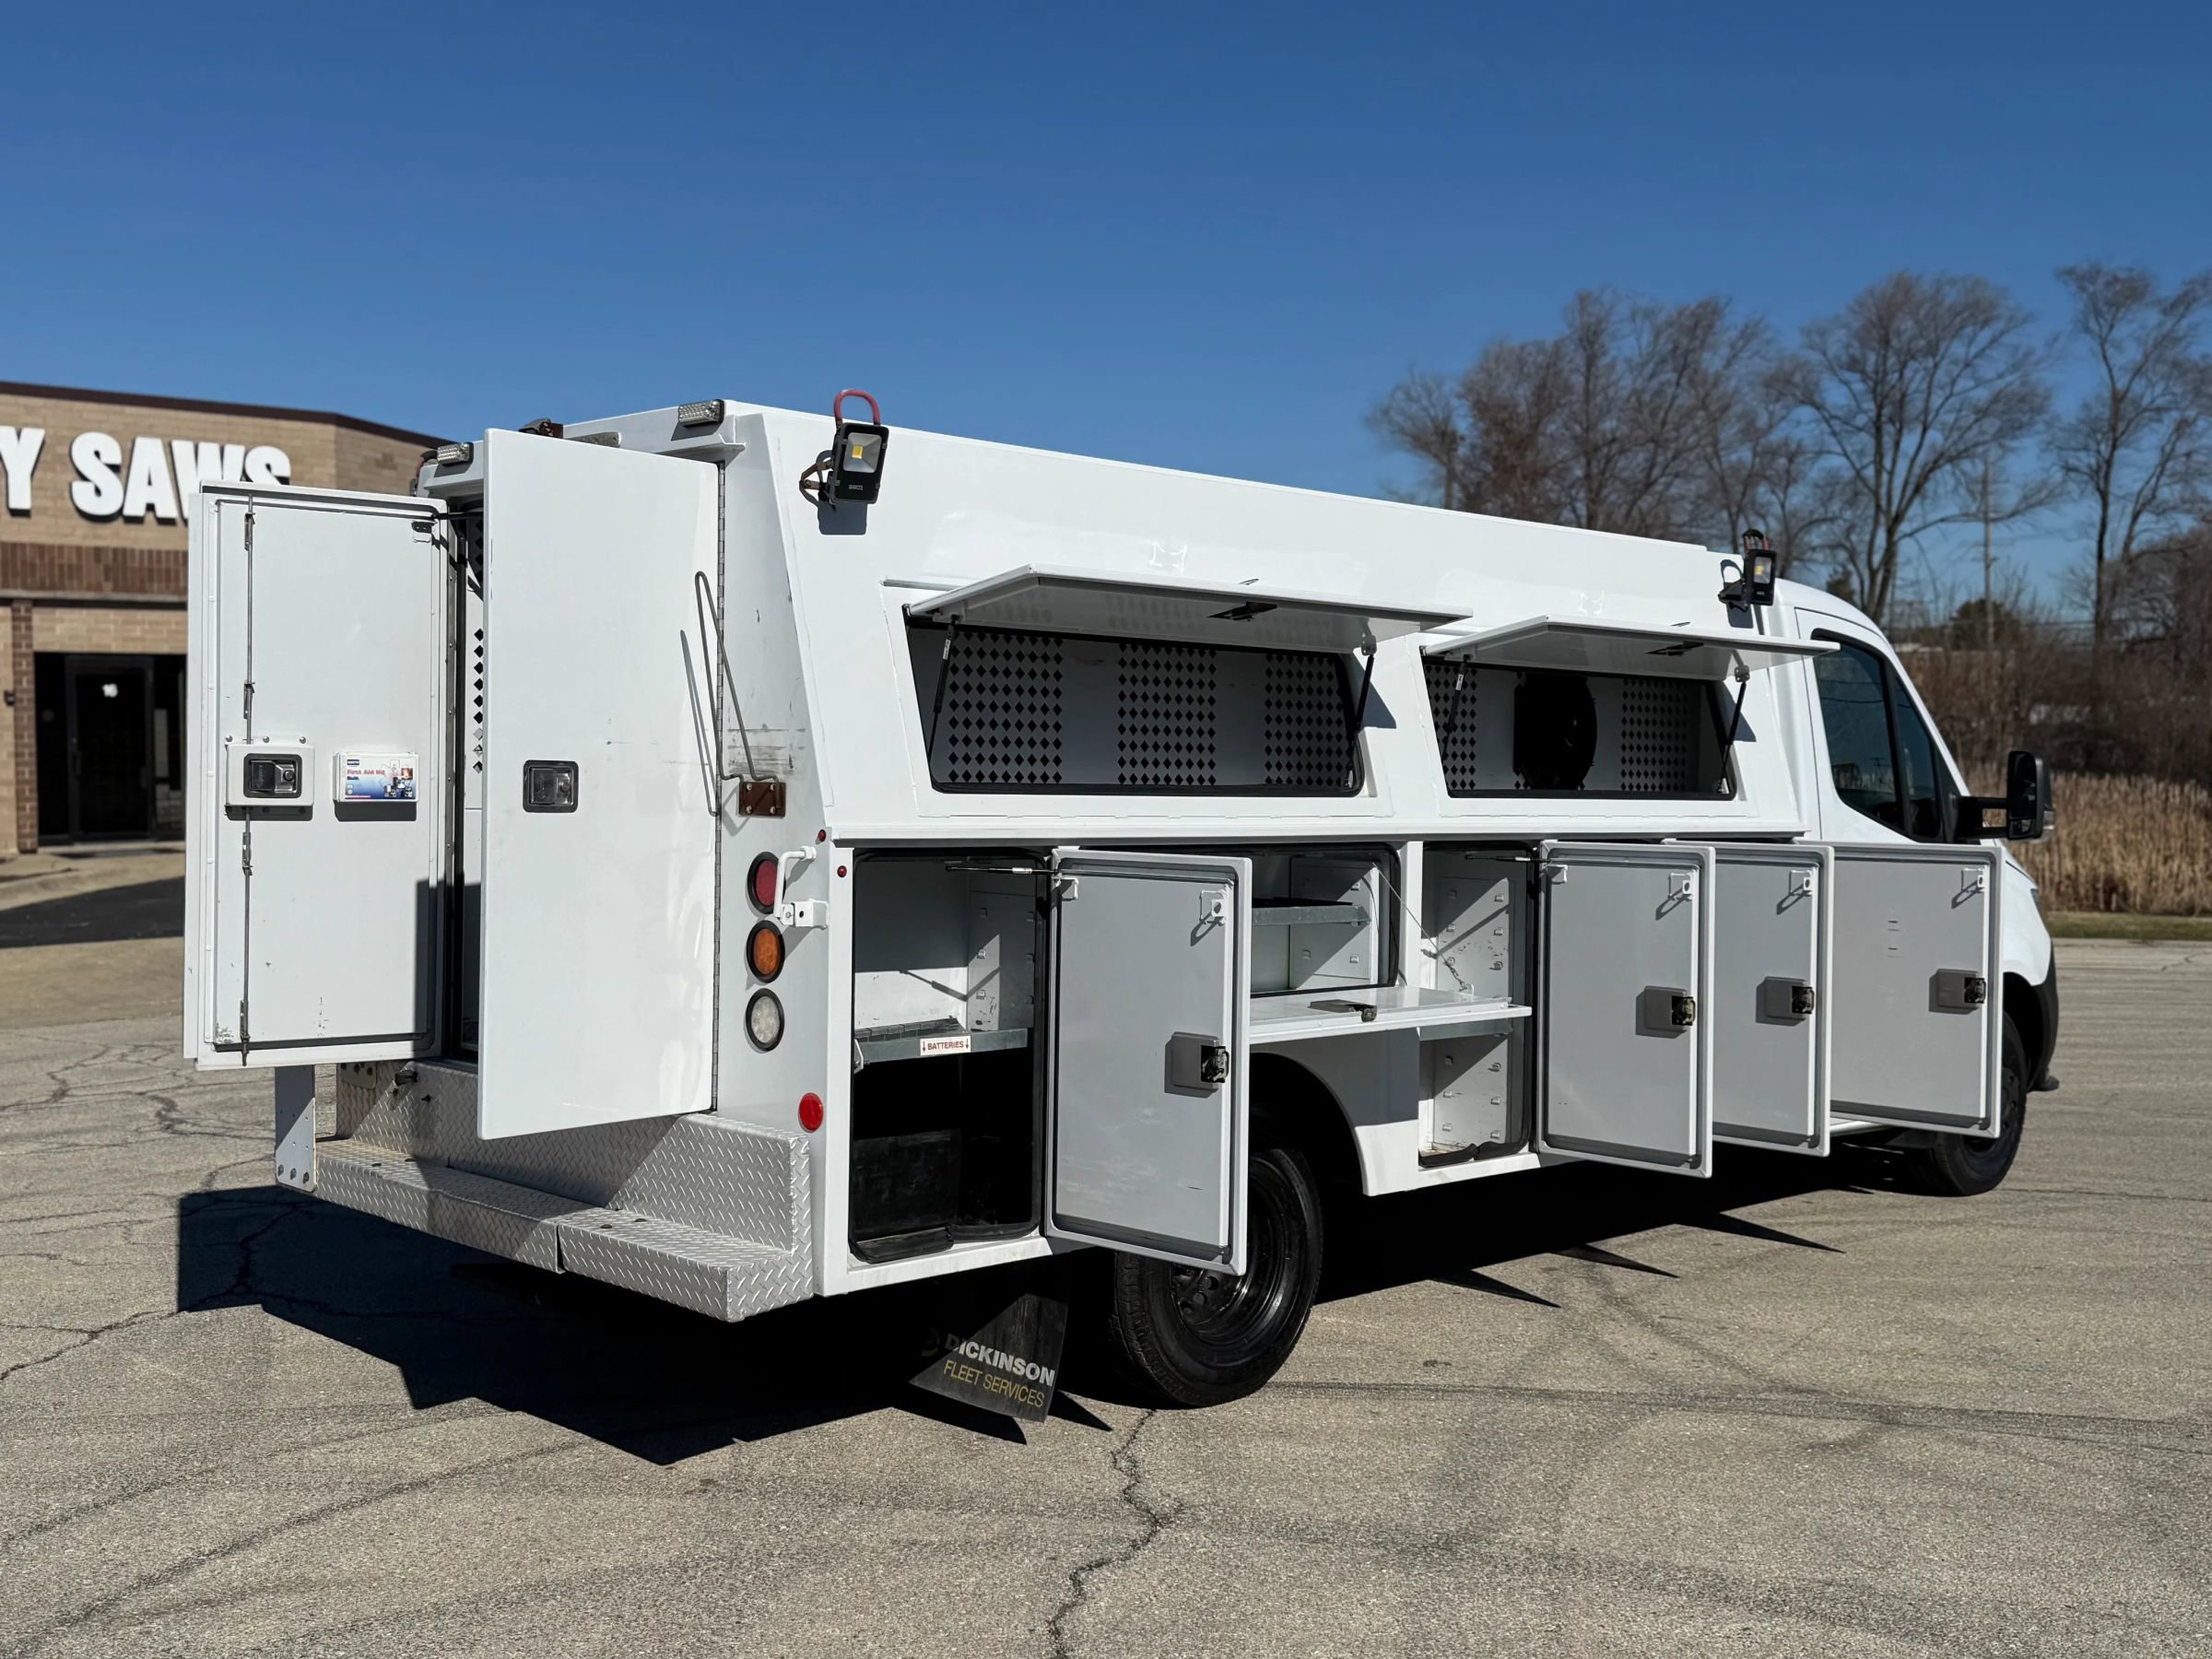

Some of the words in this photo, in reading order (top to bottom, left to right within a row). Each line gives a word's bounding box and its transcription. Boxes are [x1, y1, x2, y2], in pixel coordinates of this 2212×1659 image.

[927, 1041, 964, 1051] BATTERIES
[943, 1359, 983, 1386] FLEET
[982, 1373, 1045, 1408] SERVICES
[944, 1333, 1056, 1387] DICKINSON
